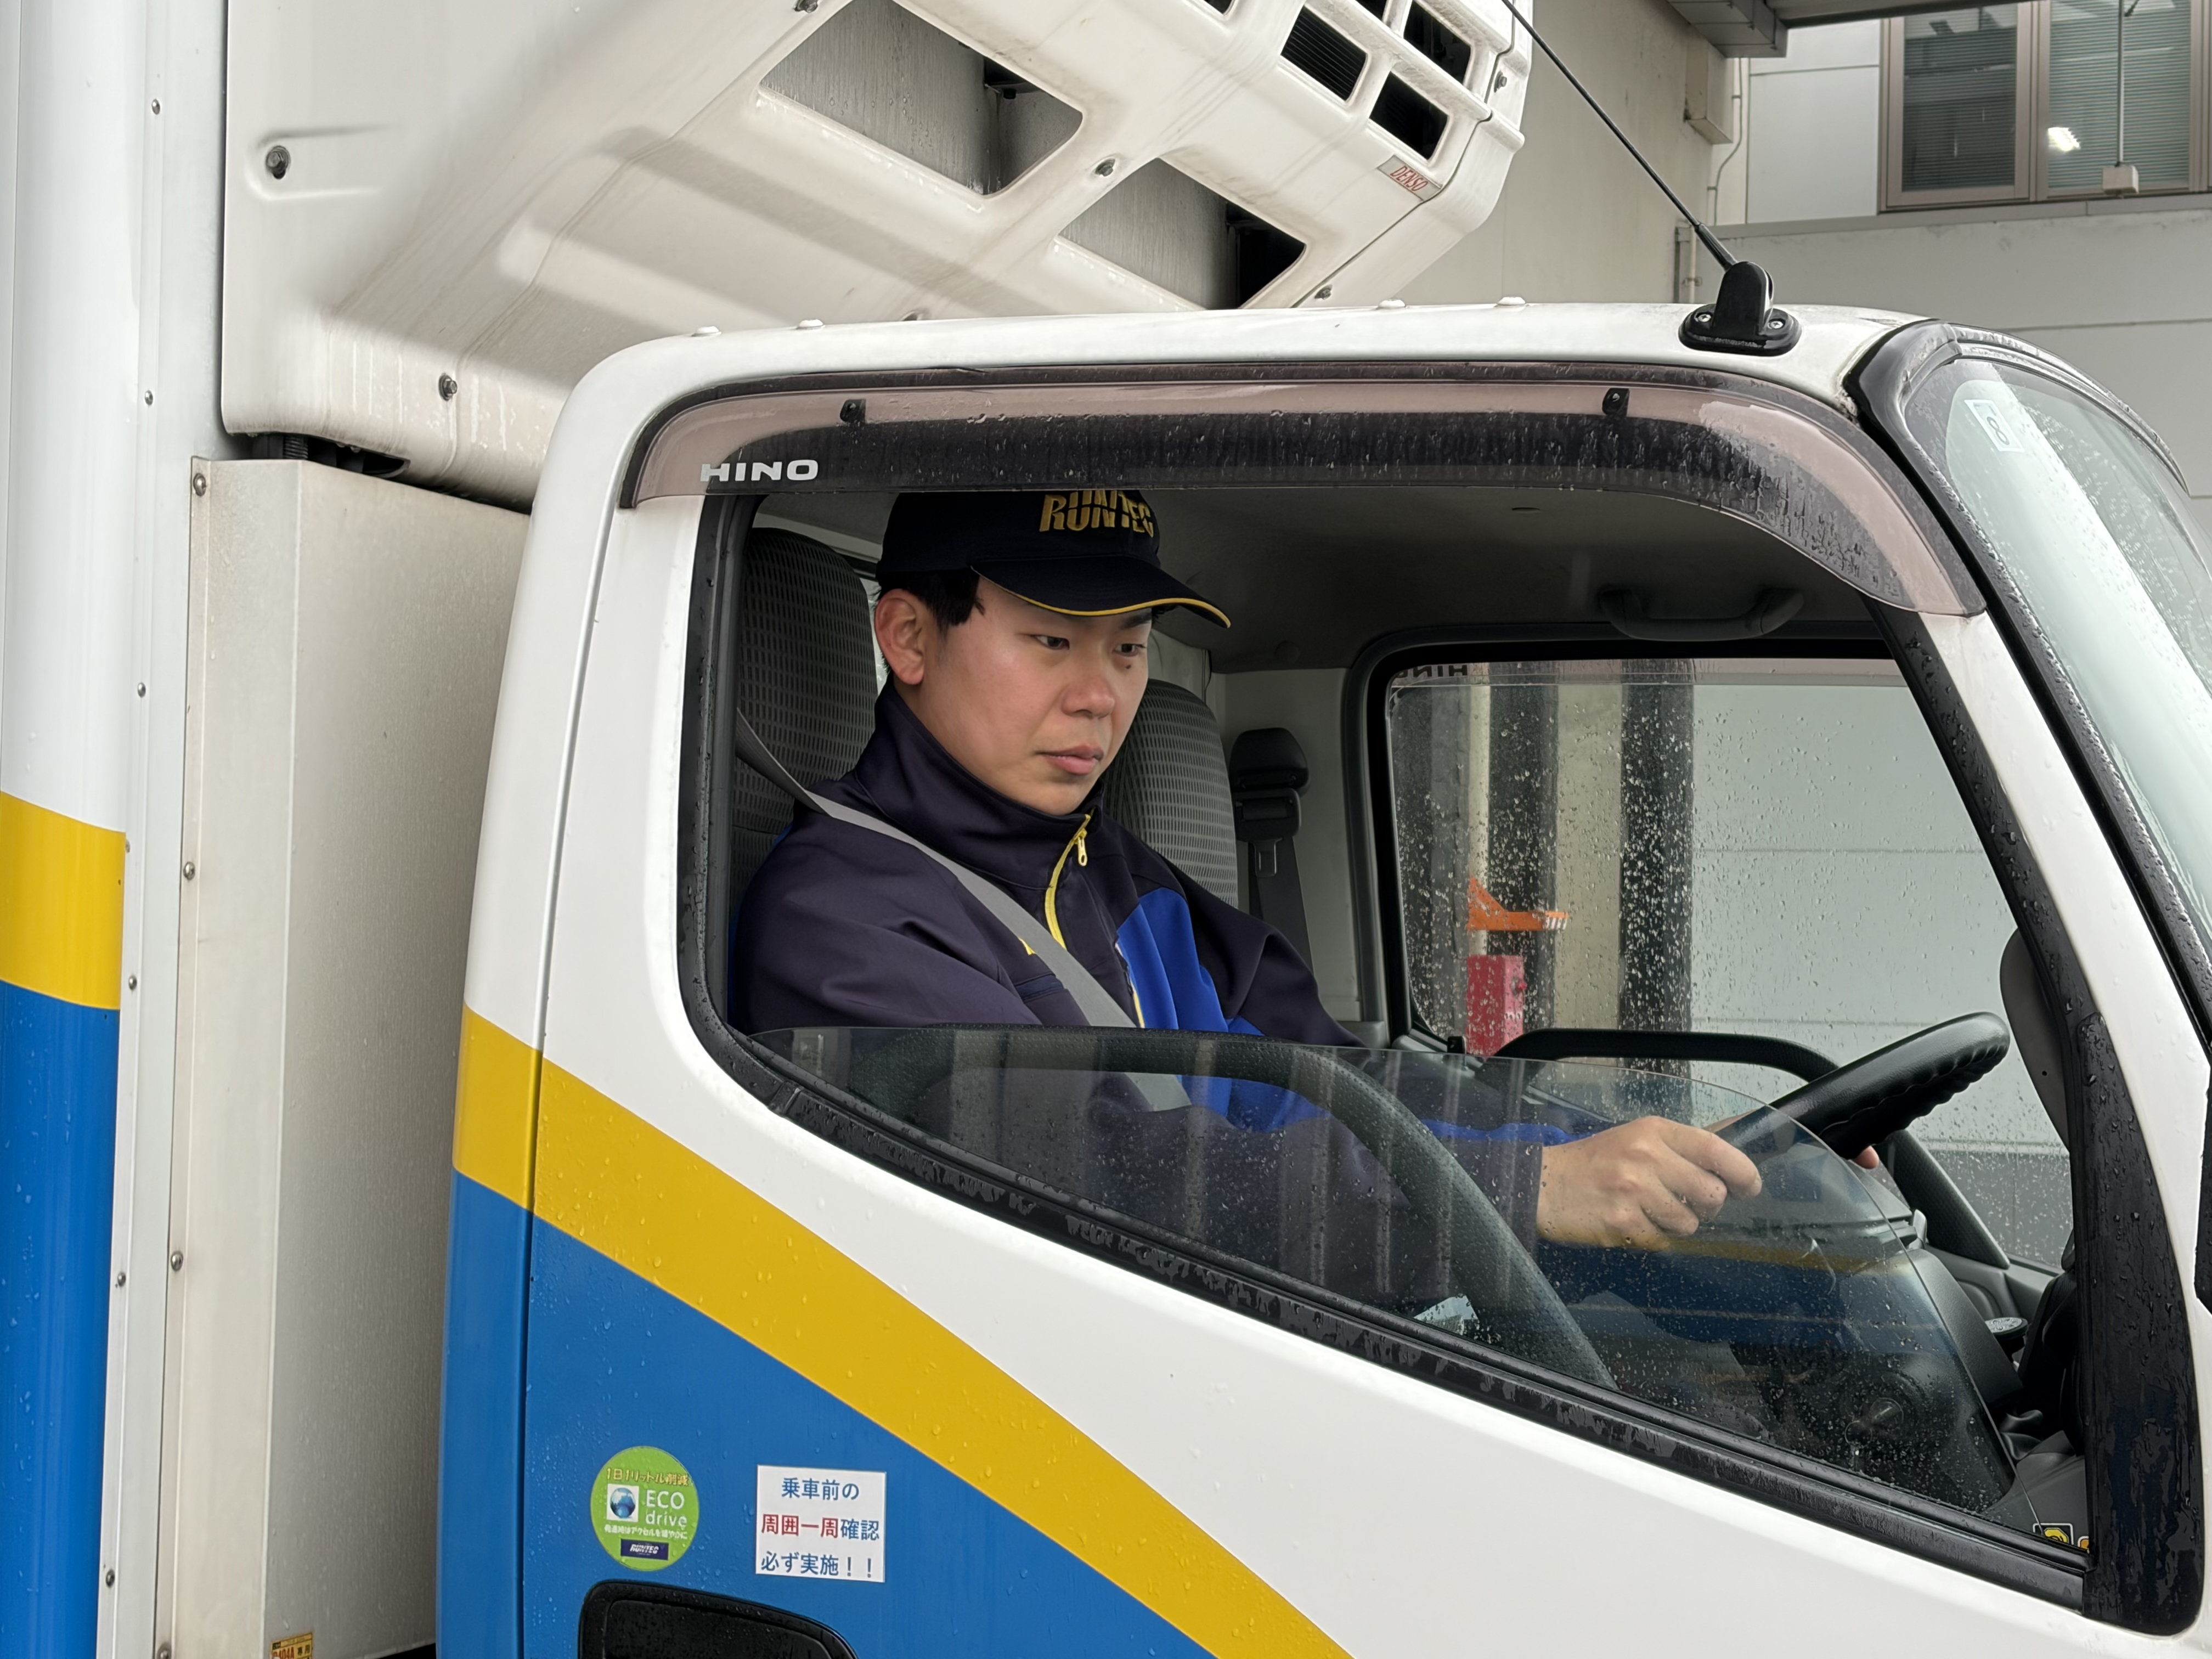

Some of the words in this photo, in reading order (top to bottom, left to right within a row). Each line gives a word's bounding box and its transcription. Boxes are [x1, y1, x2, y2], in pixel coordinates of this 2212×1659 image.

[1390, 165, 1429, 191] DENSO
[700, 459, 819, 482] HINO
[1039, 489, 1154, 538] RUNTEC
[646, 1489, 685, 1510] ECO
[781, 1477, 860, 1501] 乗車前の
[645, 1509, 687, 1528] drive
[761, 1513, 880, 1541] 周囲一周確認
